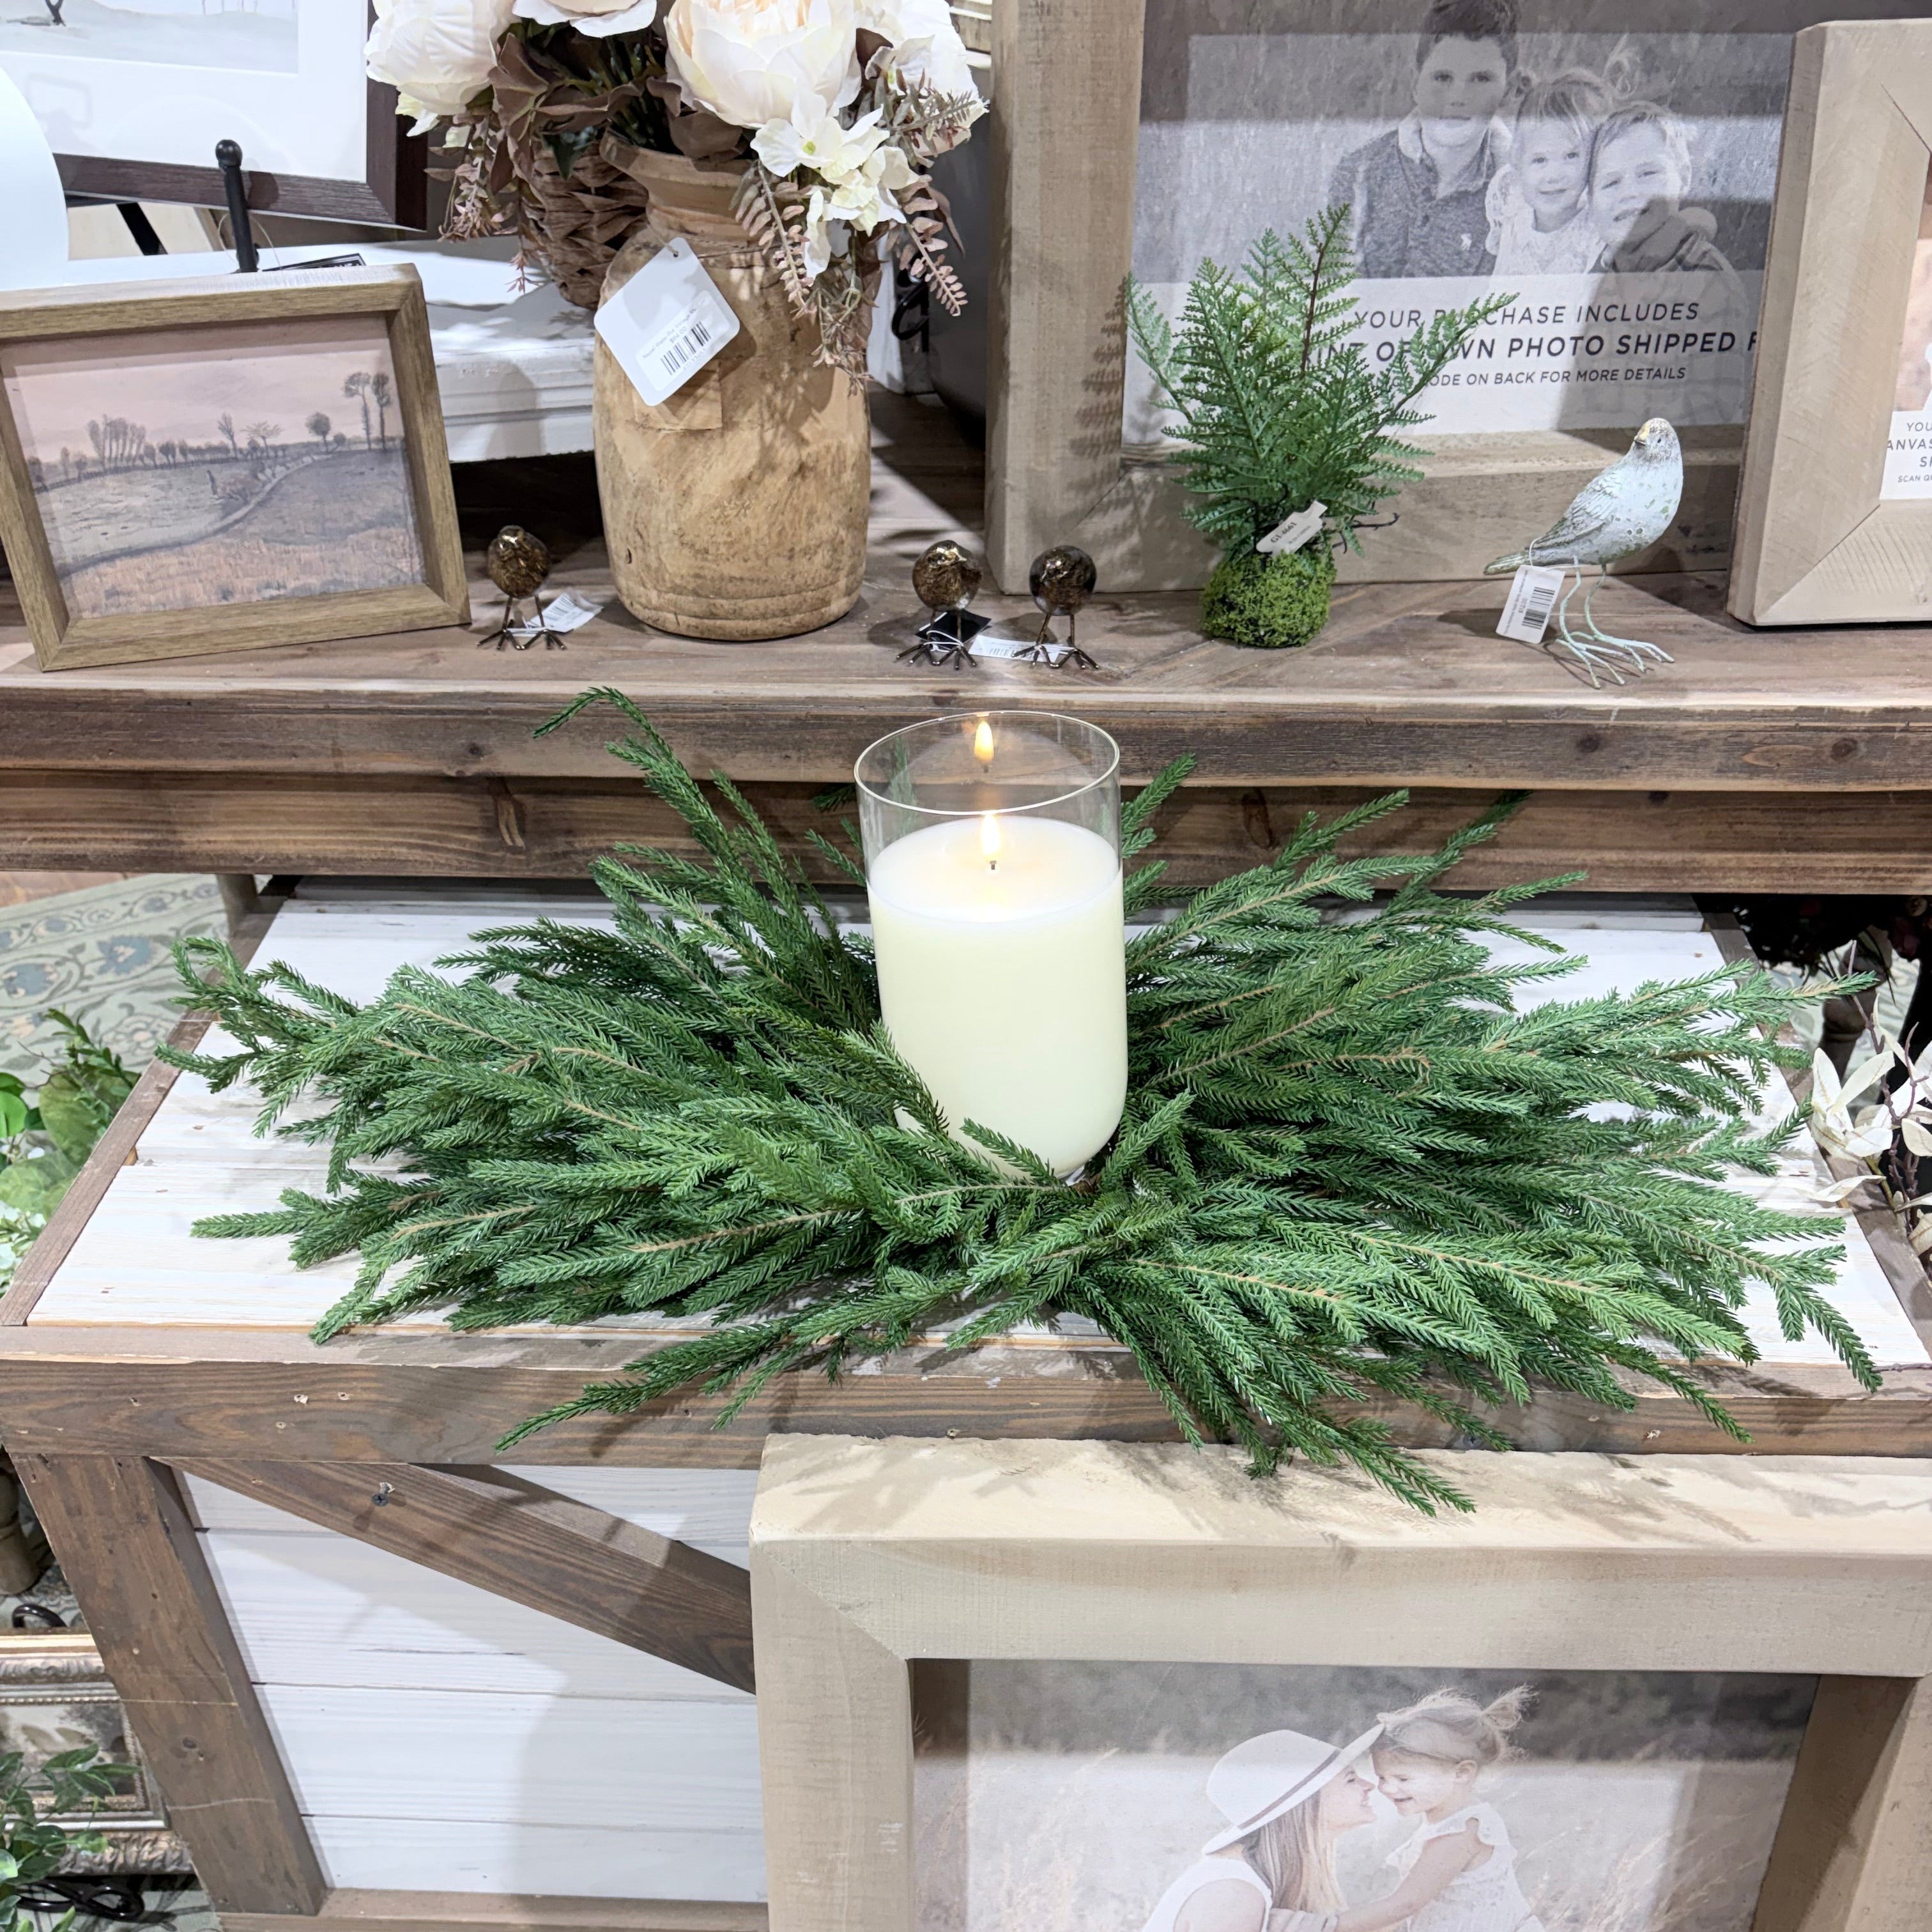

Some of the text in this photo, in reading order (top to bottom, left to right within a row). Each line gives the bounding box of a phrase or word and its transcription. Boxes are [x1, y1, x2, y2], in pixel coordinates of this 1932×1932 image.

[1354, 302, 1699, 328] YOUR PCHASE INCLUDES
[1446, 338, 1495, 360] WN
[1507, 335, 1605, 358] PHOTO
[1615, 332, 1736, 355] SHIPPED
[1430, 367, 1687, 387] ODE ON BACK FOR MORE DETAILS
[1897, 475, 1921, 483] SCAN
